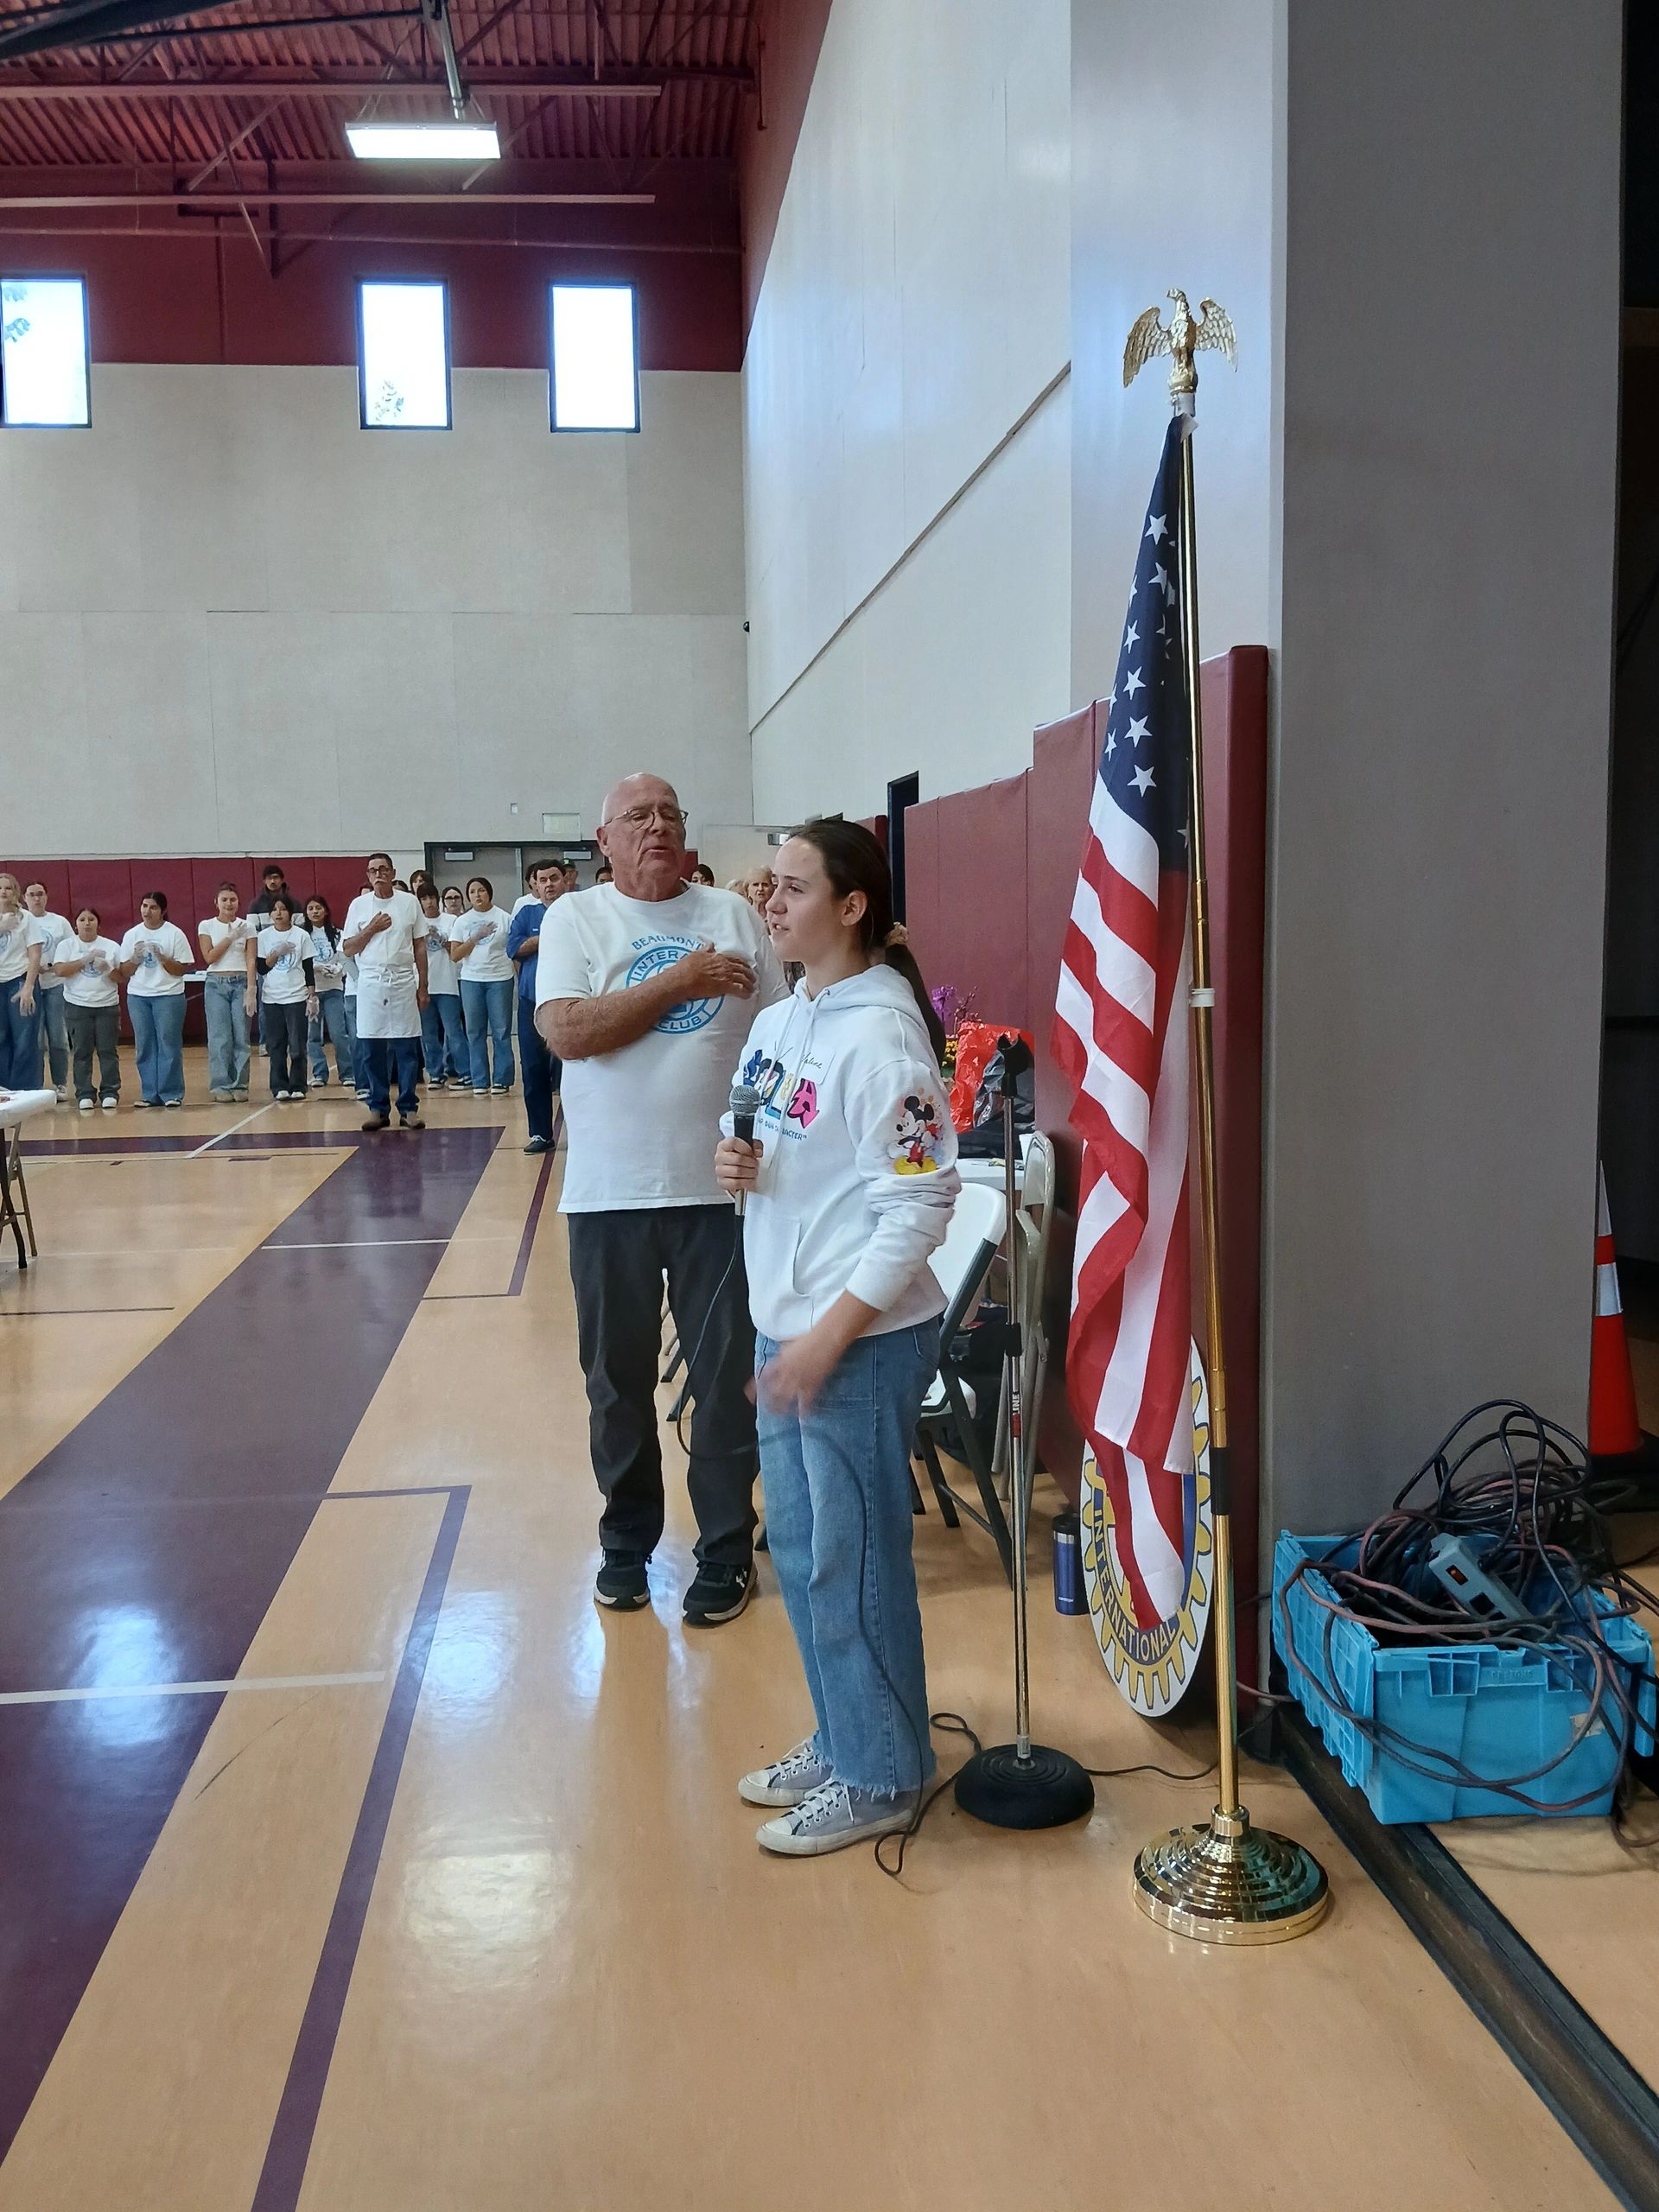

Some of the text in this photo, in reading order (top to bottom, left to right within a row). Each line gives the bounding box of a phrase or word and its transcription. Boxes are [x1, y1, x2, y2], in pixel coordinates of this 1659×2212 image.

[634, 950, 689, 977] INTER
[658, 1015, 702, 1030] CLUB
[1095, 1509, 1176, 1662] INTERNATIONAL
